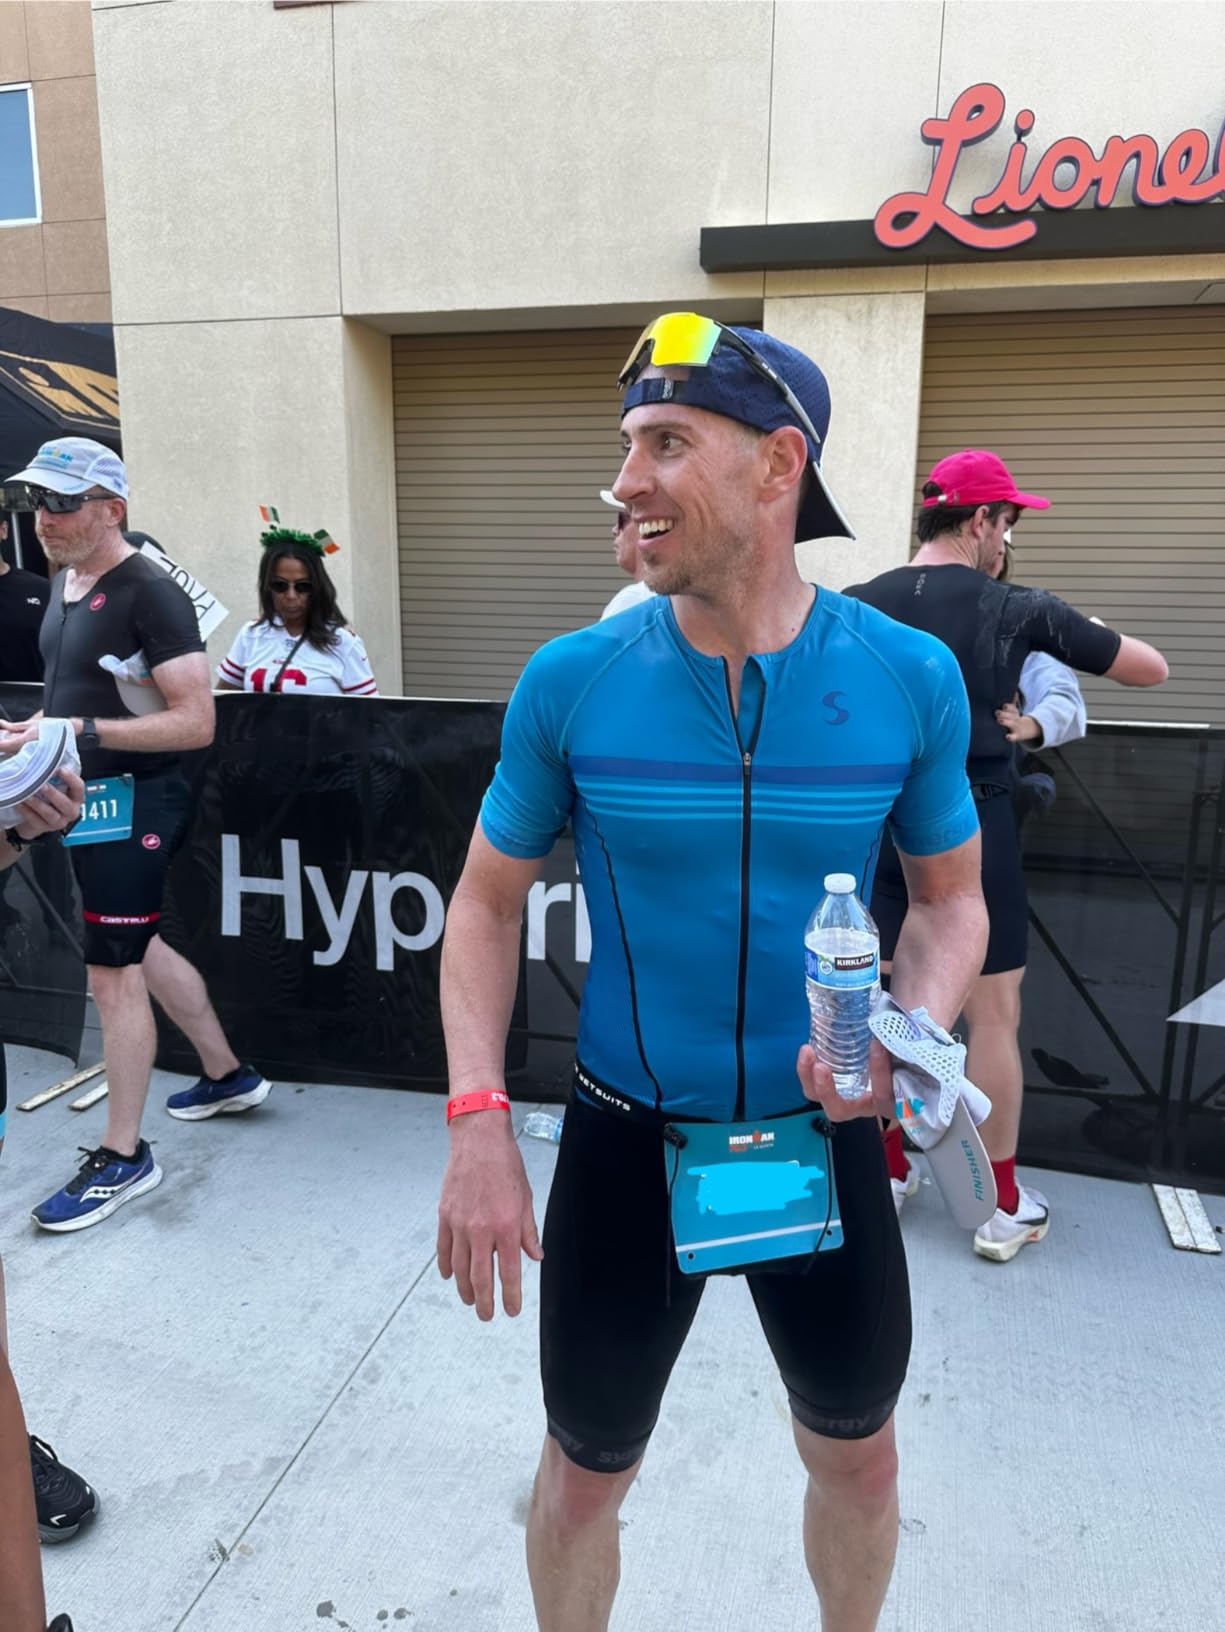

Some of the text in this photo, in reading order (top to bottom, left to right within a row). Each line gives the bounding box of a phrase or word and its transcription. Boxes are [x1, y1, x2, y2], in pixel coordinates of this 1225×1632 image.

[874, 82, 1225, 249] Lione
[81, 799, 118, 821] 1411
[220, 833, 593, 972] Hypri
[836, 955, 874, 966] KIRKLAND
[961, 1139, 985, 1201] FINISHER
